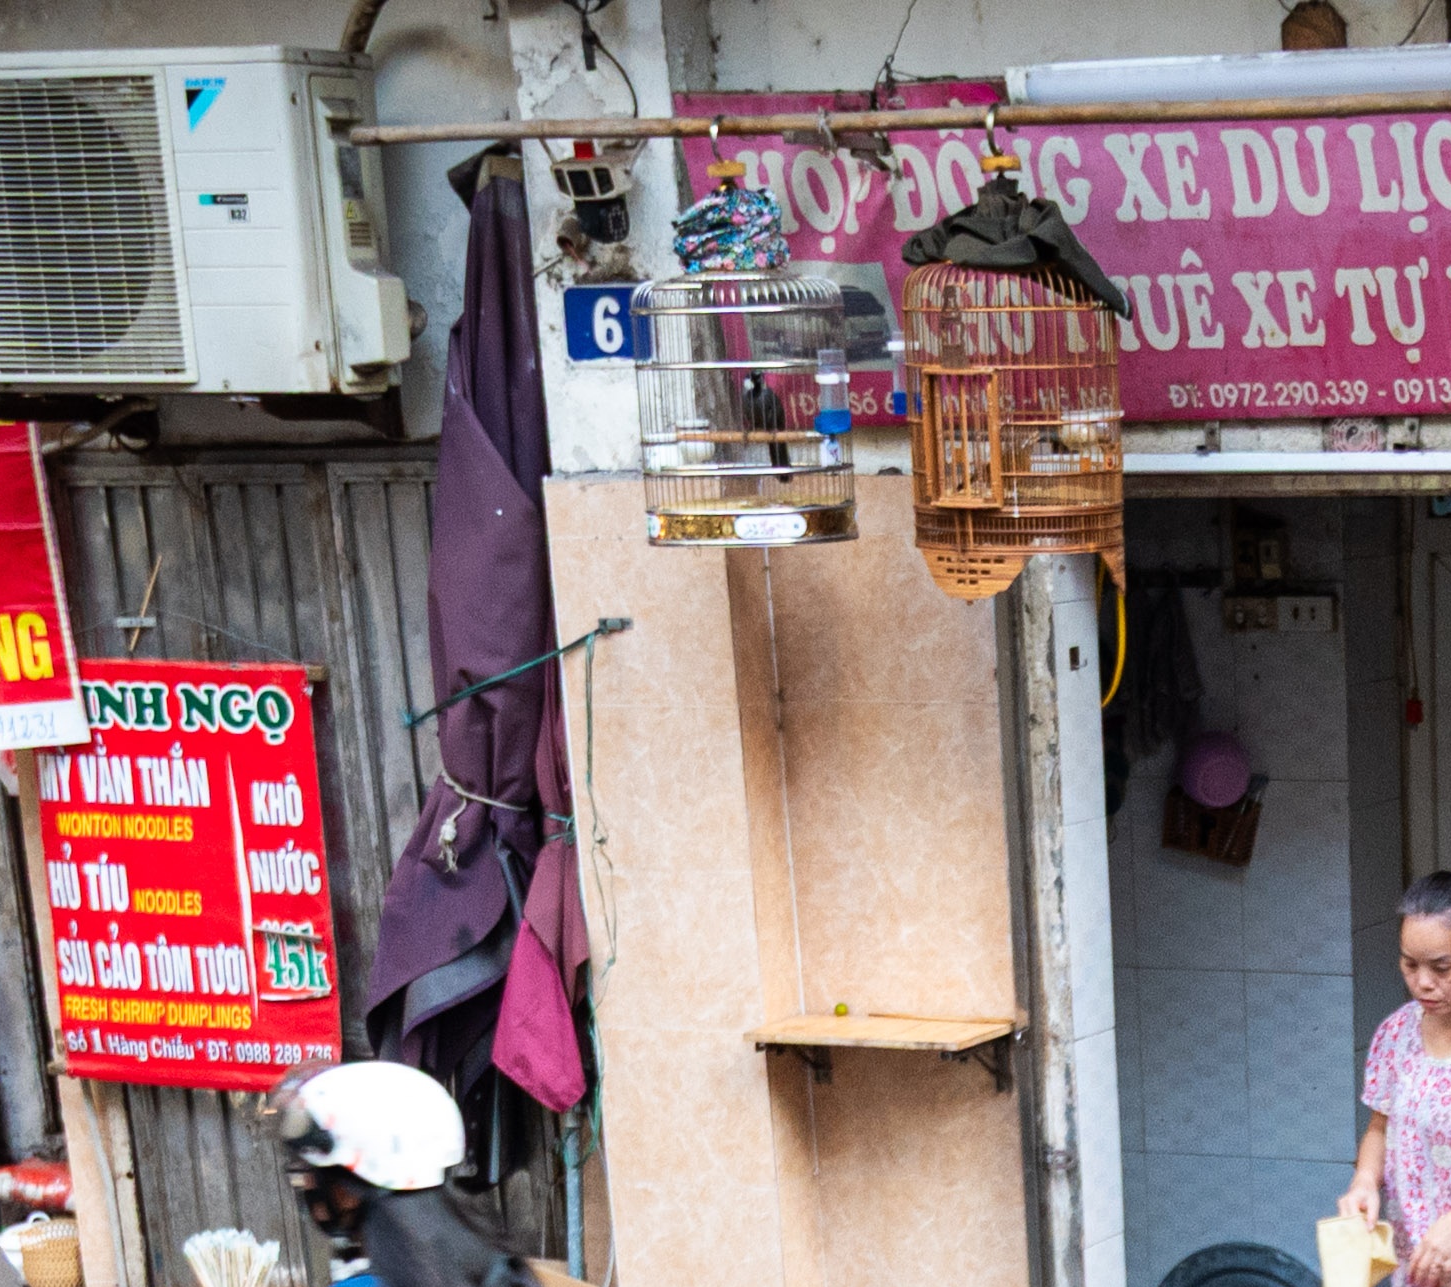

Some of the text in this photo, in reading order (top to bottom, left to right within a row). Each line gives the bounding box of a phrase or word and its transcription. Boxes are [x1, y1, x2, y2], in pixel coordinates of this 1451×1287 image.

[1105, 131, 1211, 222] XE
[1220, 125, 1330, 218] DU
[592, 295, 625, 354] 6
[1232, 268, 1326, 348] XE
[1335, 256, 1429, 364] TỰ
[1168, 383, 1204, 409] ĐT:
[1209, 378, 1368, 409] 0972.290.339
[81, 683, 293, 744] INH NGỌ
[56, 812, 194, 842] WONTON NOODLES
[252, 773, 304, 827] KHÔ
[249, 839, 322, 895] NƯỚC
[133, 889, 203, 916] NOODLES
[95, 921, 142, 991] CẢO
[144, 933, 195, 993] TÔM
[64, 994, 252, 1030] FRESH SHRIMP DUMPLINGS
[275, 1045, 302, 1065] 289
